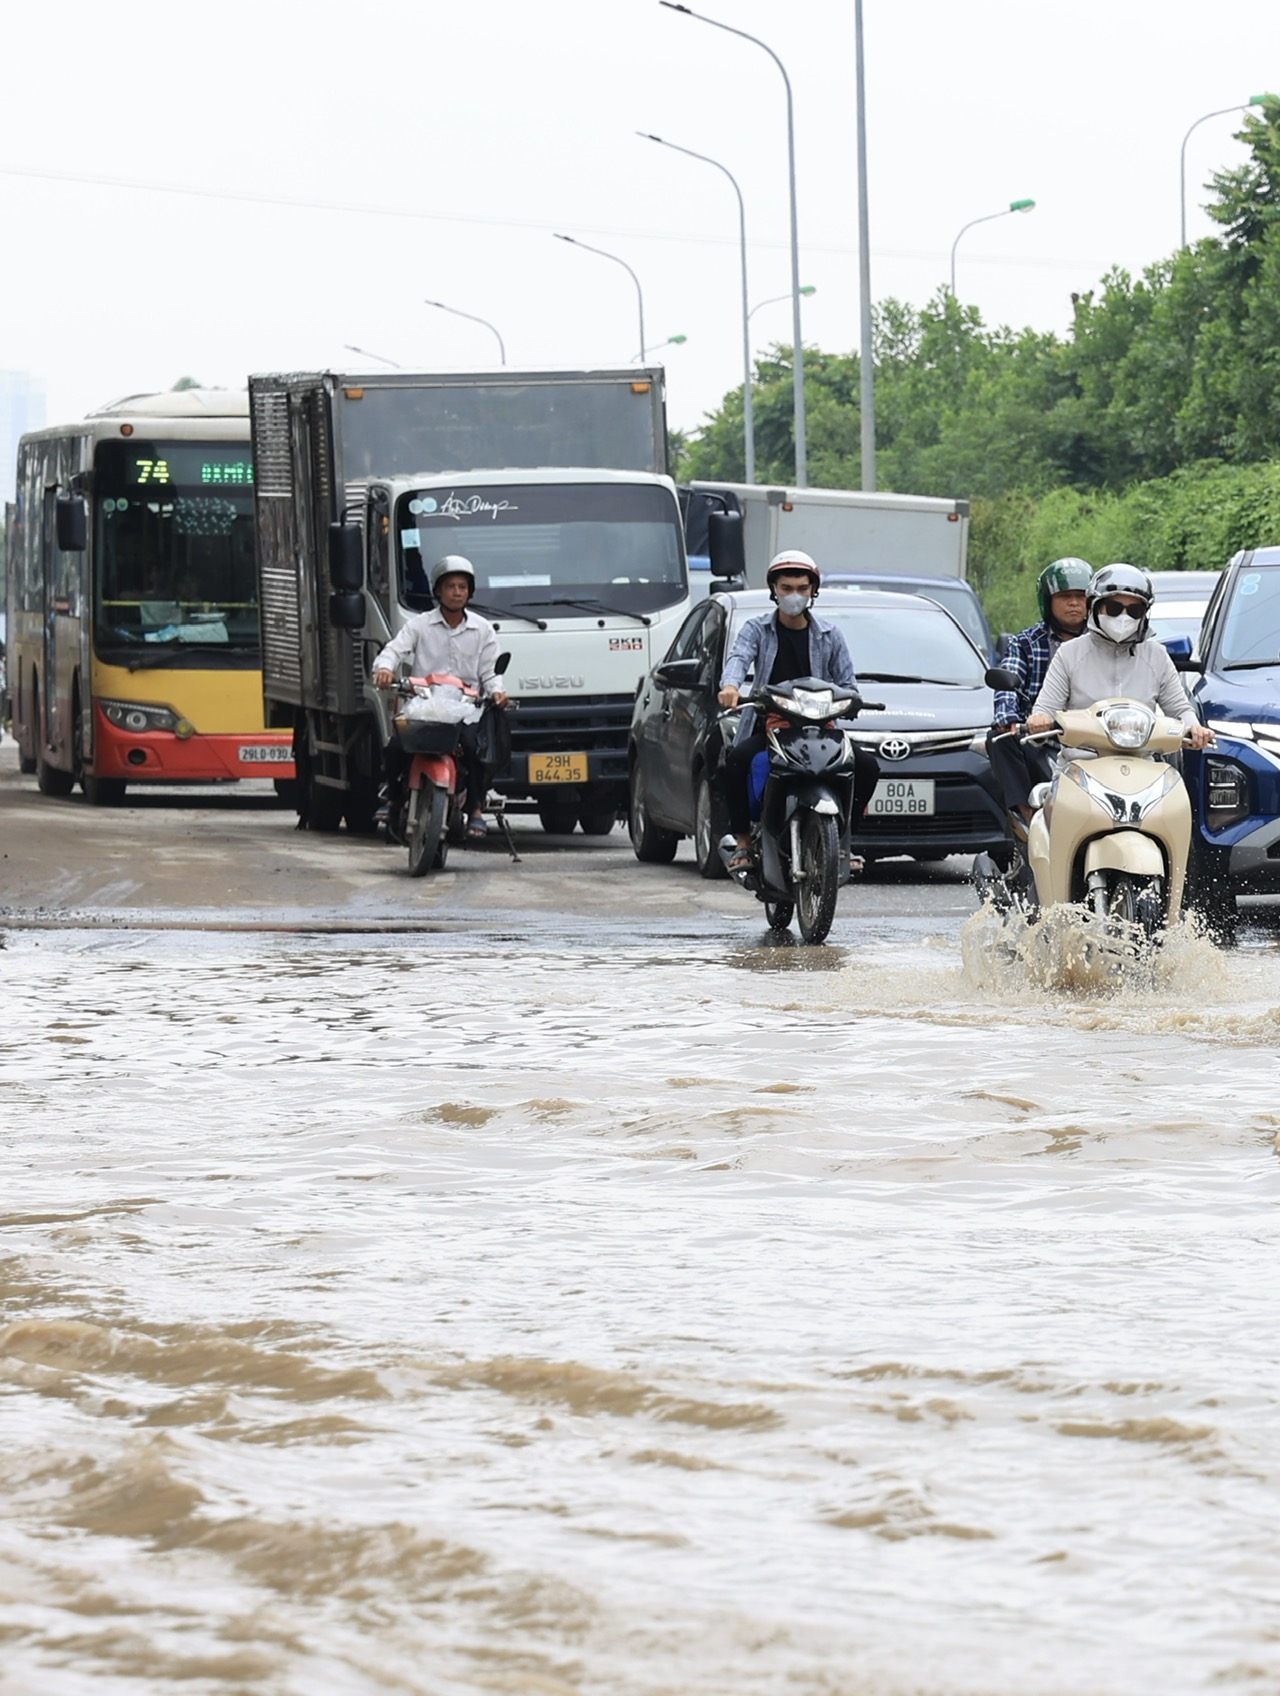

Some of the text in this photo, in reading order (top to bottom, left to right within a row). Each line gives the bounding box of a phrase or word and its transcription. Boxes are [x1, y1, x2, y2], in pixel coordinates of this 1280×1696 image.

[136, 460, 169, 483] 74
[519, 675, 584, 690] ISUZU
[546, 755, 571, 768] 29H
[536, 768, 581, 781] 844.35
[887, 783, 915, 797] 80A
[875, 799, 926, 813] 009.88
